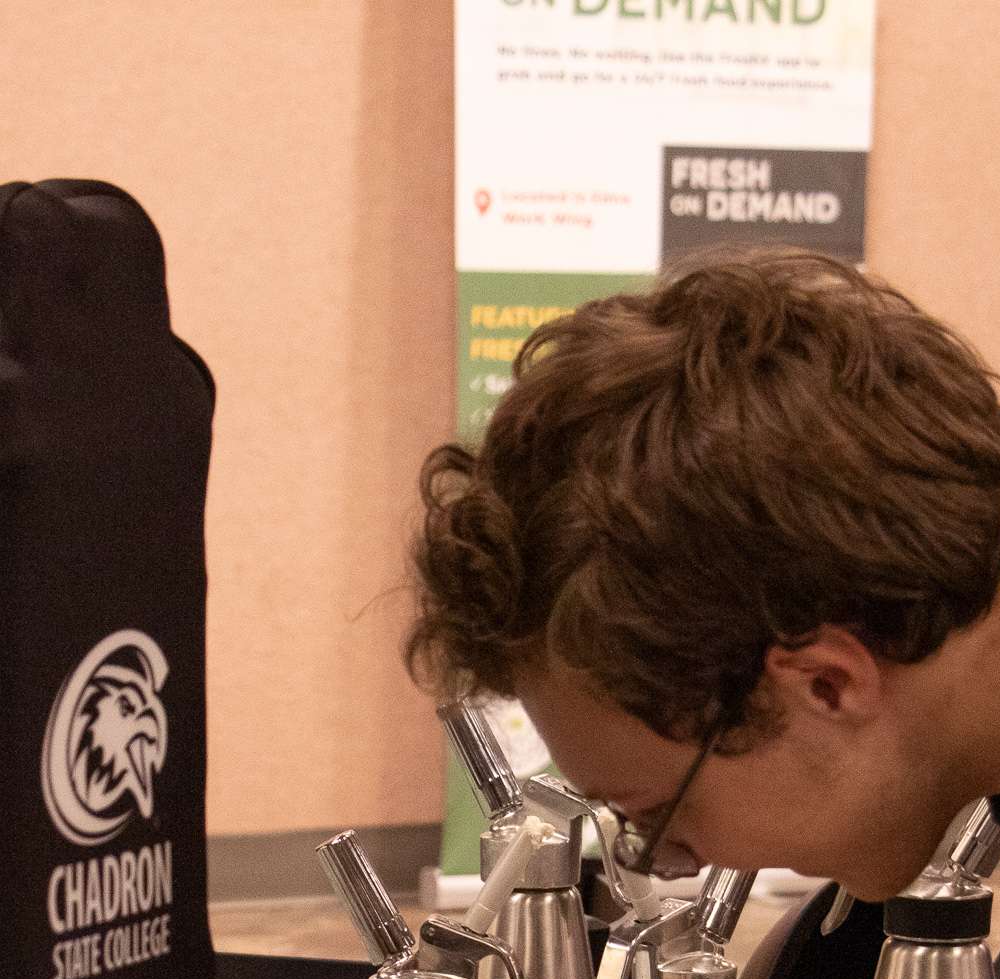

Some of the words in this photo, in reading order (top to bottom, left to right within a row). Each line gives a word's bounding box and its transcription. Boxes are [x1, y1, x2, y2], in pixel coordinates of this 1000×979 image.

[669, 156, 771, 191] FRESH
[669, 196, 700, 217] ON
[706, 190, 841, 224] DEMAND
[47, 840, 173, 935] CHADRON
[103, 913, 171, 970] COLLEGE
